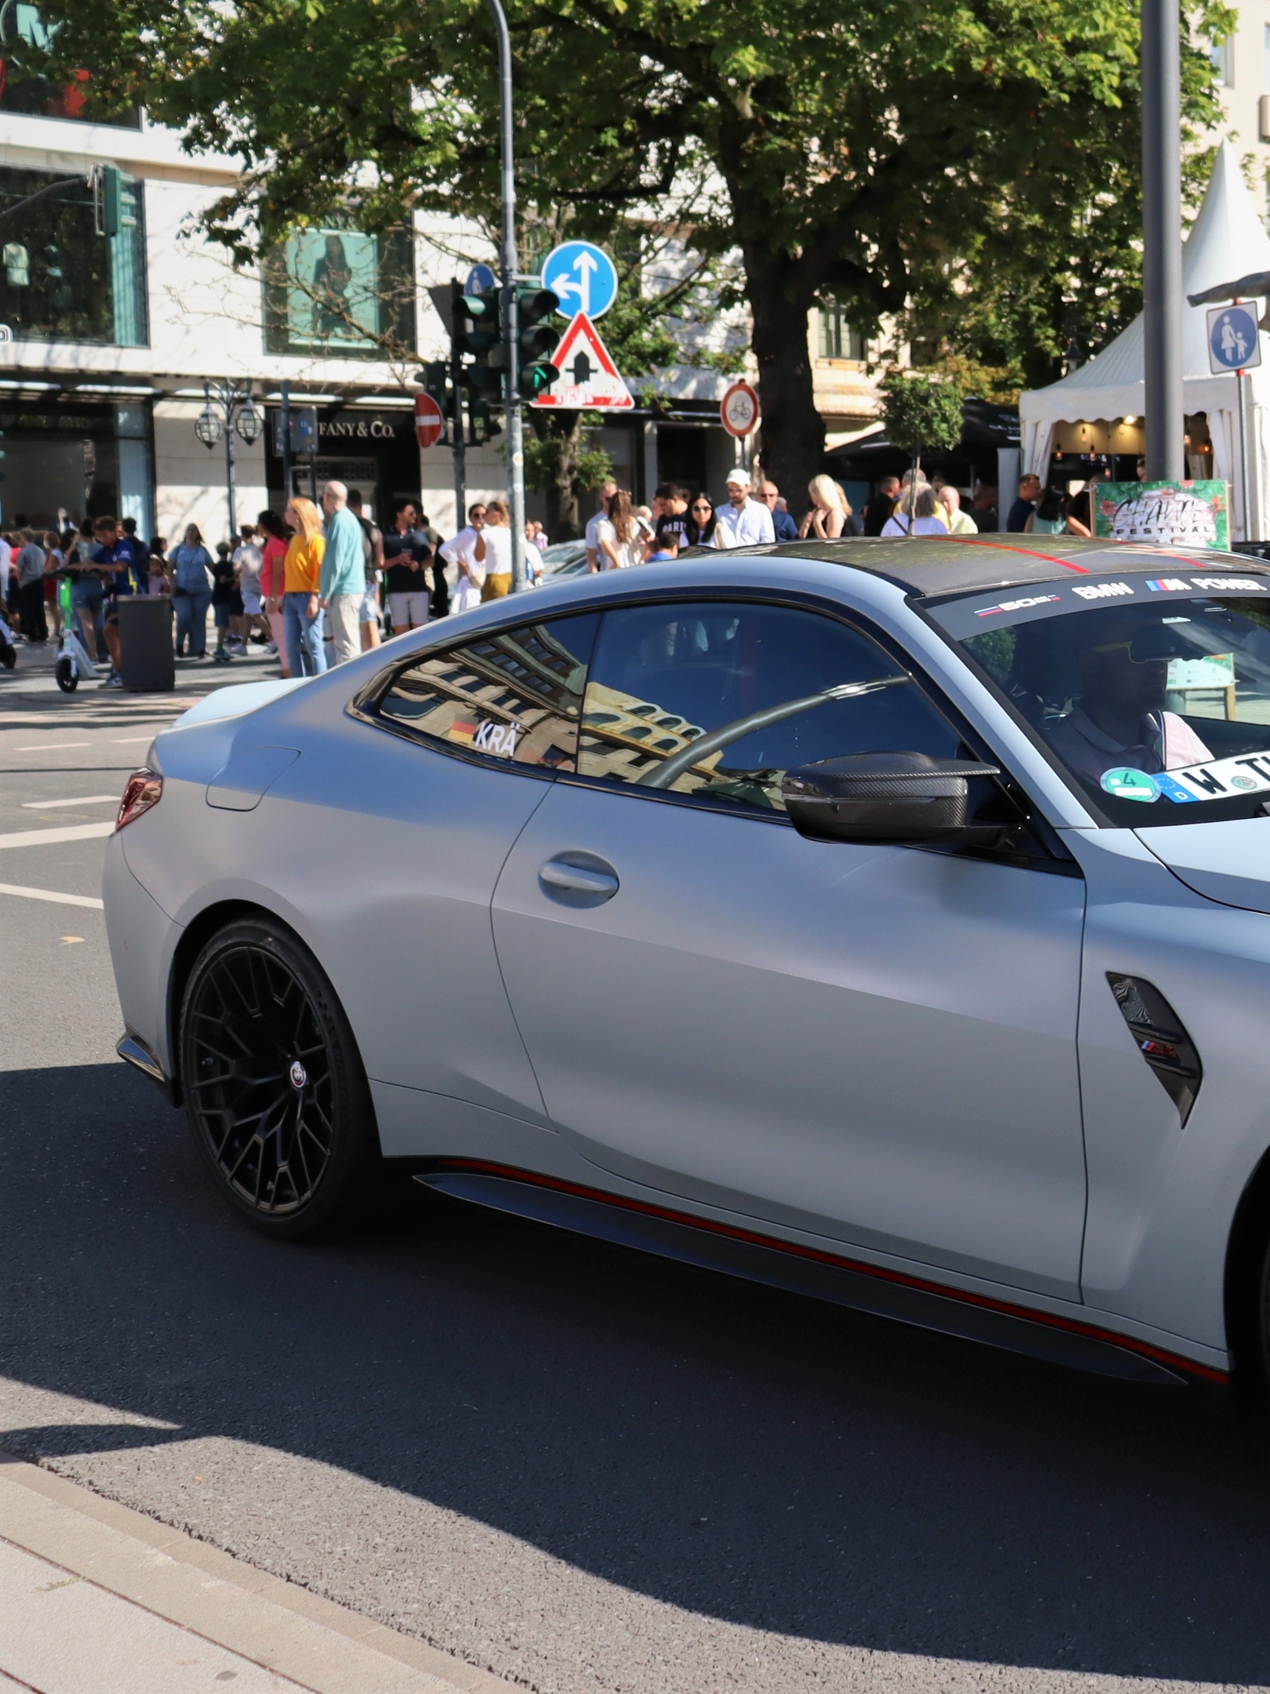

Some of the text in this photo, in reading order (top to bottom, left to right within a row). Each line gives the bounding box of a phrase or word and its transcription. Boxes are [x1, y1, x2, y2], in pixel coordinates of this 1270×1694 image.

[319, 422, 355, 436] FANY
[357, 422, 368, 437] &
[1116, 526, 1211, 535] FESTIVAL
[1072, 582, 1135, 600] BMW
[1190, 578, 1268, 591] POWER
[475, 721, 521, 757] KRÄ
[1123, 772, 1137, 787] 4
[1182, 768, 1228, 795] W
